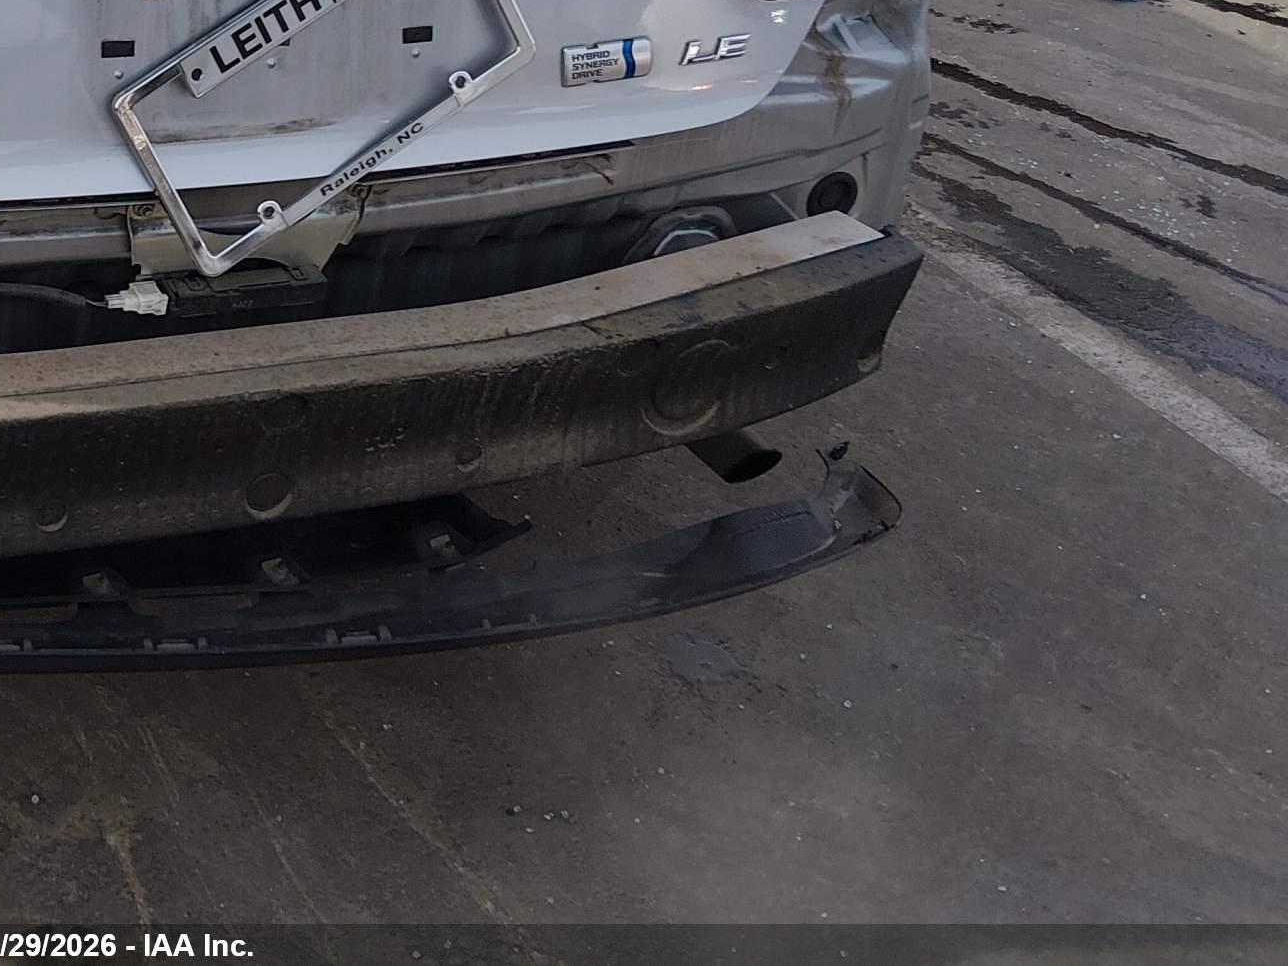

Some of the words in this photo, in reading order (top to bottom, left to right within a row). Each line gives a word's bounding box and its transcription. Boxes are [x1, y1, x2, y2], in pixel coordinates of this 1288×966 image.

[571, 49, 611, 63] HYBRID
[678, 33, 752, 66] LE
[571, 57, 620, 71] SYNERGY
[571, 68, 604, 80] DRIVE
[319, 145, 395, 196] Raleigh,
[396, 121, 425, 147] NC
